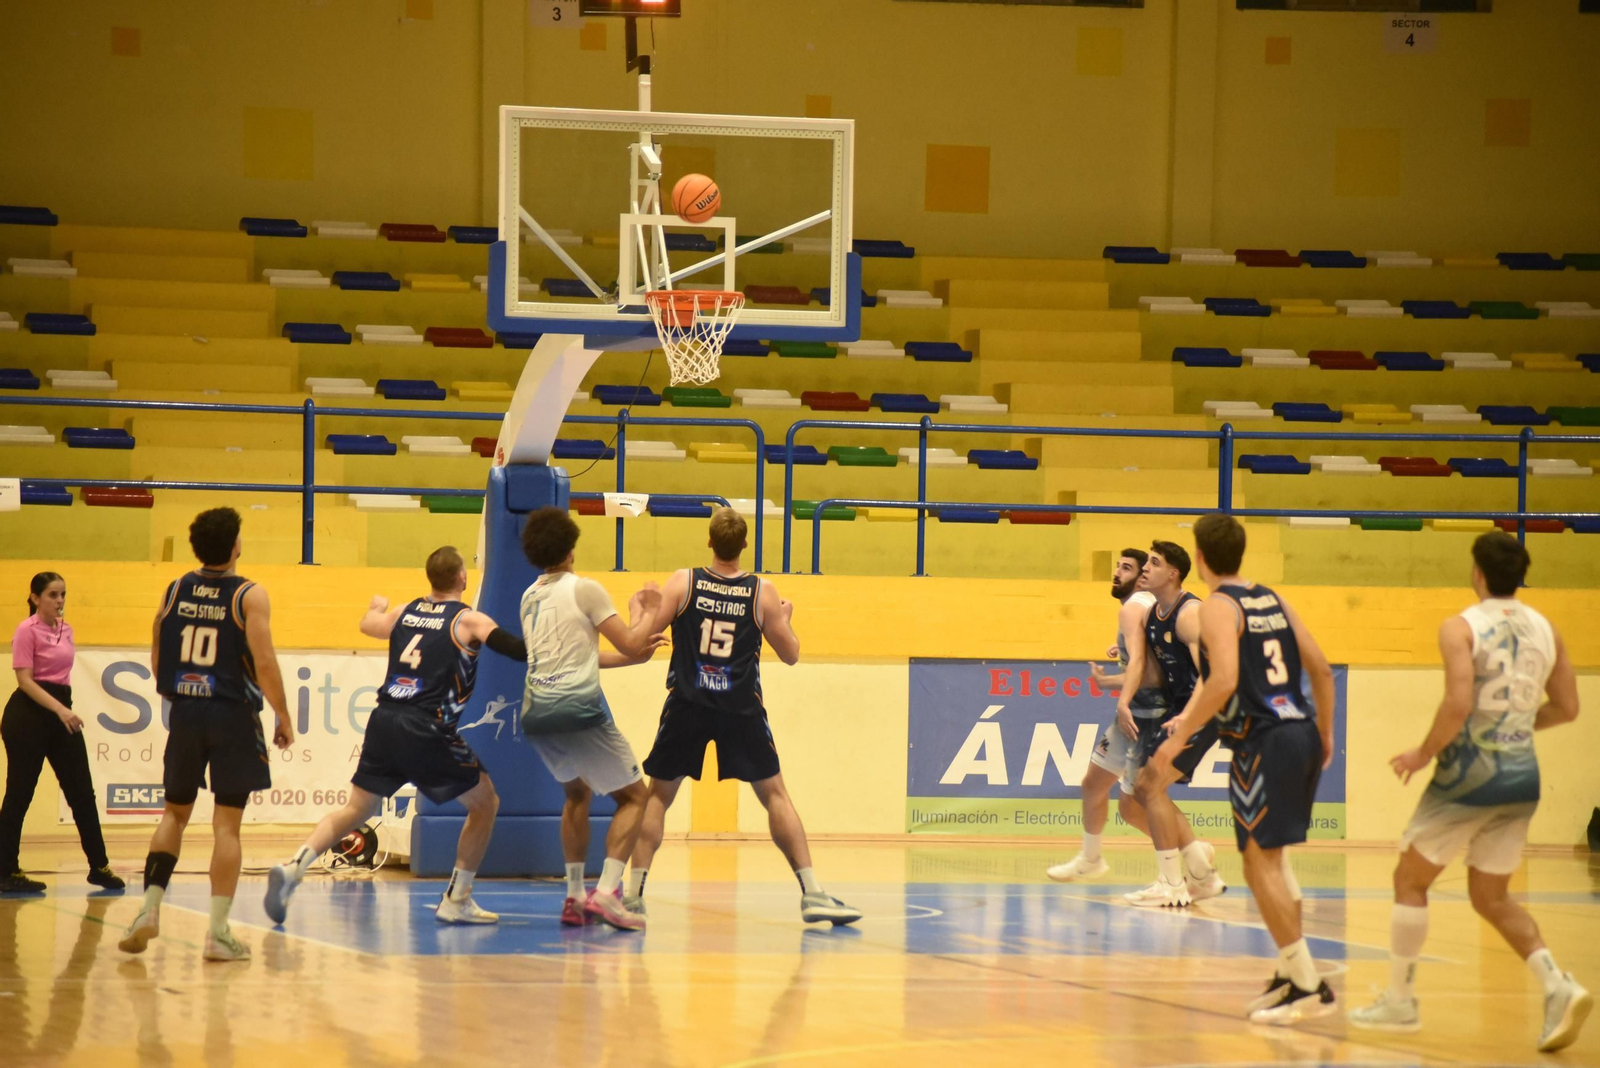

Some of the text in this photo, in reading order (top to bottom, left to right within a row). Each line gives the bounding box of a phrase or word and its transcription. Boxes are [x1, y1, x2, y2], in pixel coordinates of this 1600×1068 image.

[552, 6, 562, 21] 3
[1391, 19, 1430, 28] SECTOR
[1405, 33, 1415, 47] 4
[198, 604, 226, 620] STROG
[715, 601, 746, 616] STROG
[416, 617, 445, 630] STROG
[180, 624, 218, 667] 10
[700, 618, 736, 658] 15
[399, 633, 423, 669] 4
[1263, 638, 1289, 686] 3
[270, 789, 306, 806] 020
[312, 789, 348, 806] 666
[911, 809, 999, 825] Iluminación
[1014, 810, 1086, 826] Electróni
